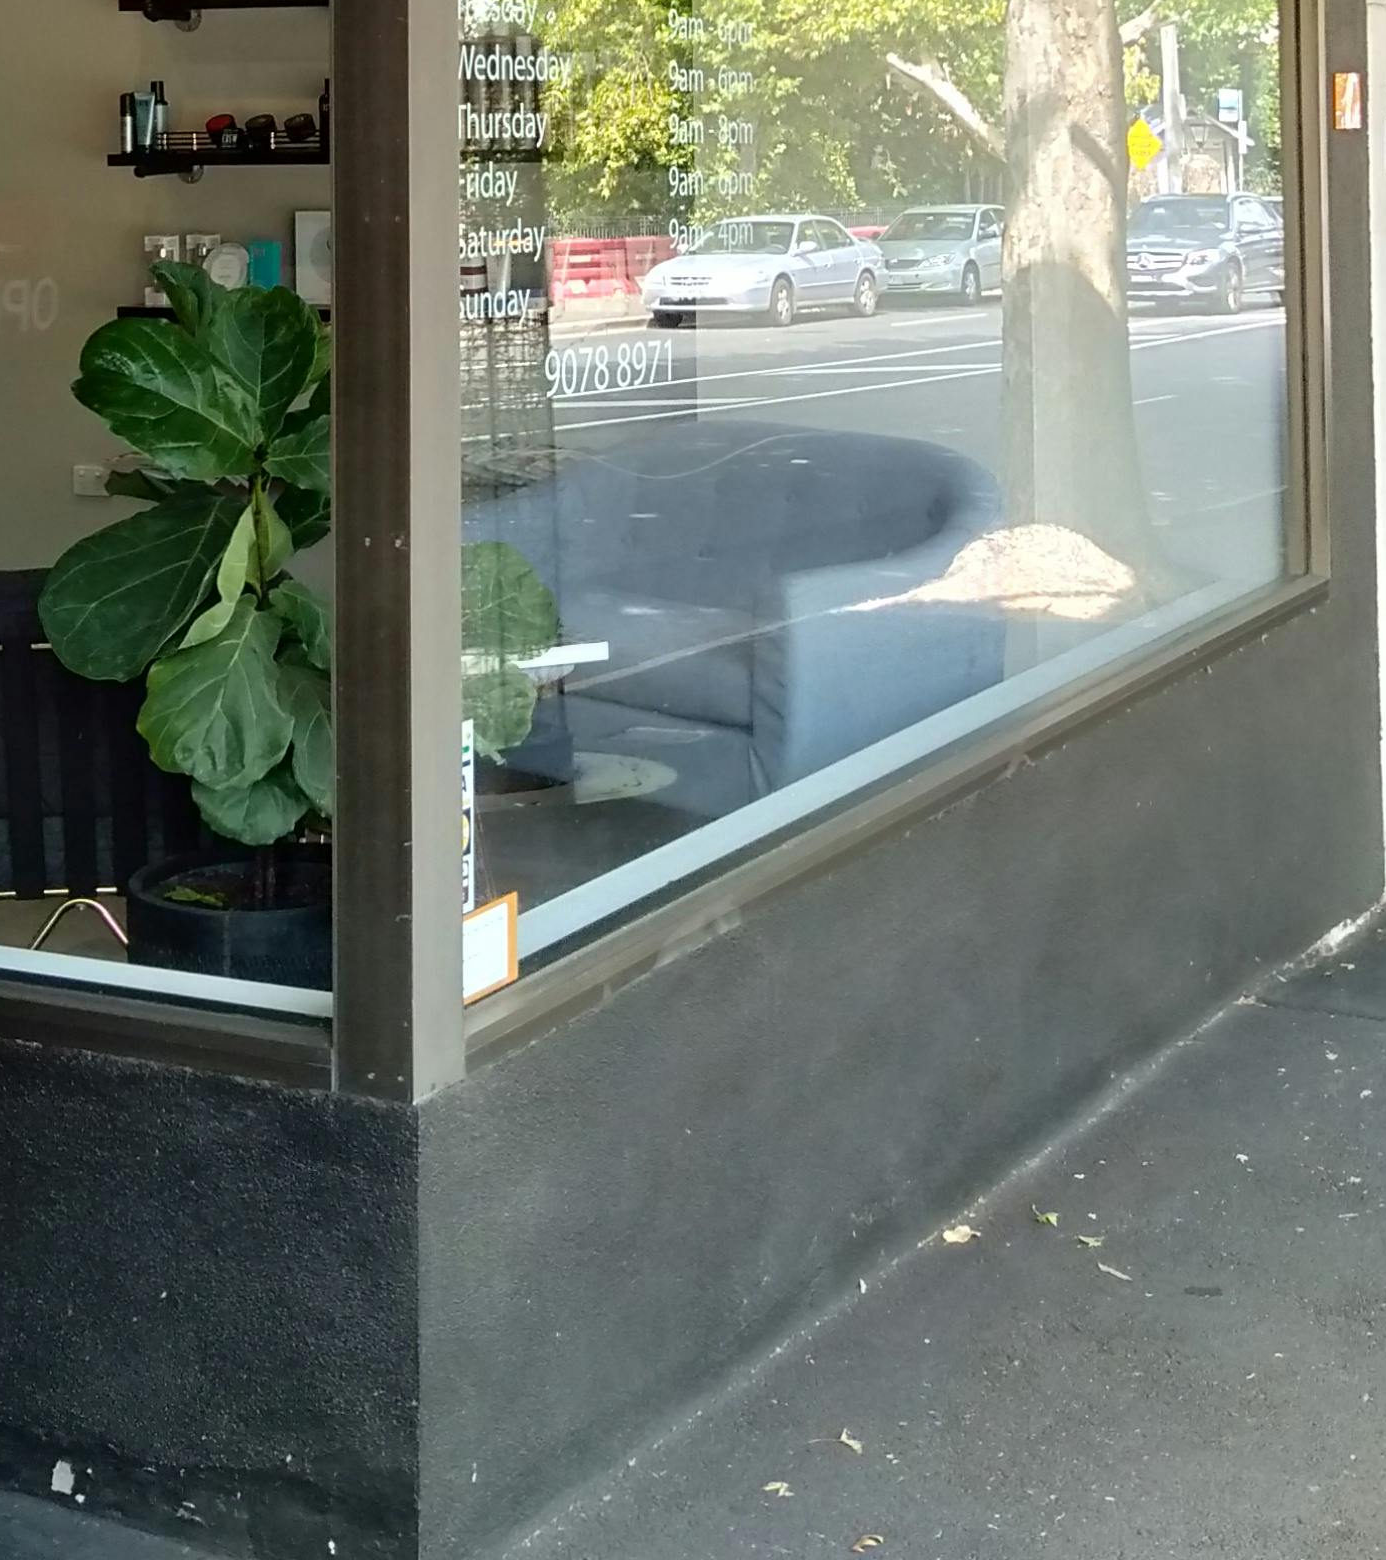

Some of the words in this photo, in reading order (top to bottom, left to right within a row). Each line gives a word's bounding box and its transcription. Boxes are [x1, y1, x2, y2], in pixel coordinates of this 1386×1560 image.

[669, 59, 704, 91] 9am
[669, 113, 704, 144] 9am
[718, 114, 753, 149] 8pm
[669, 166, 704, 197] 9am
[718, 222, 753, 252] 4pm
[544, 345, 610, 398] 9078
[616, 339, 673, 387] 8971
